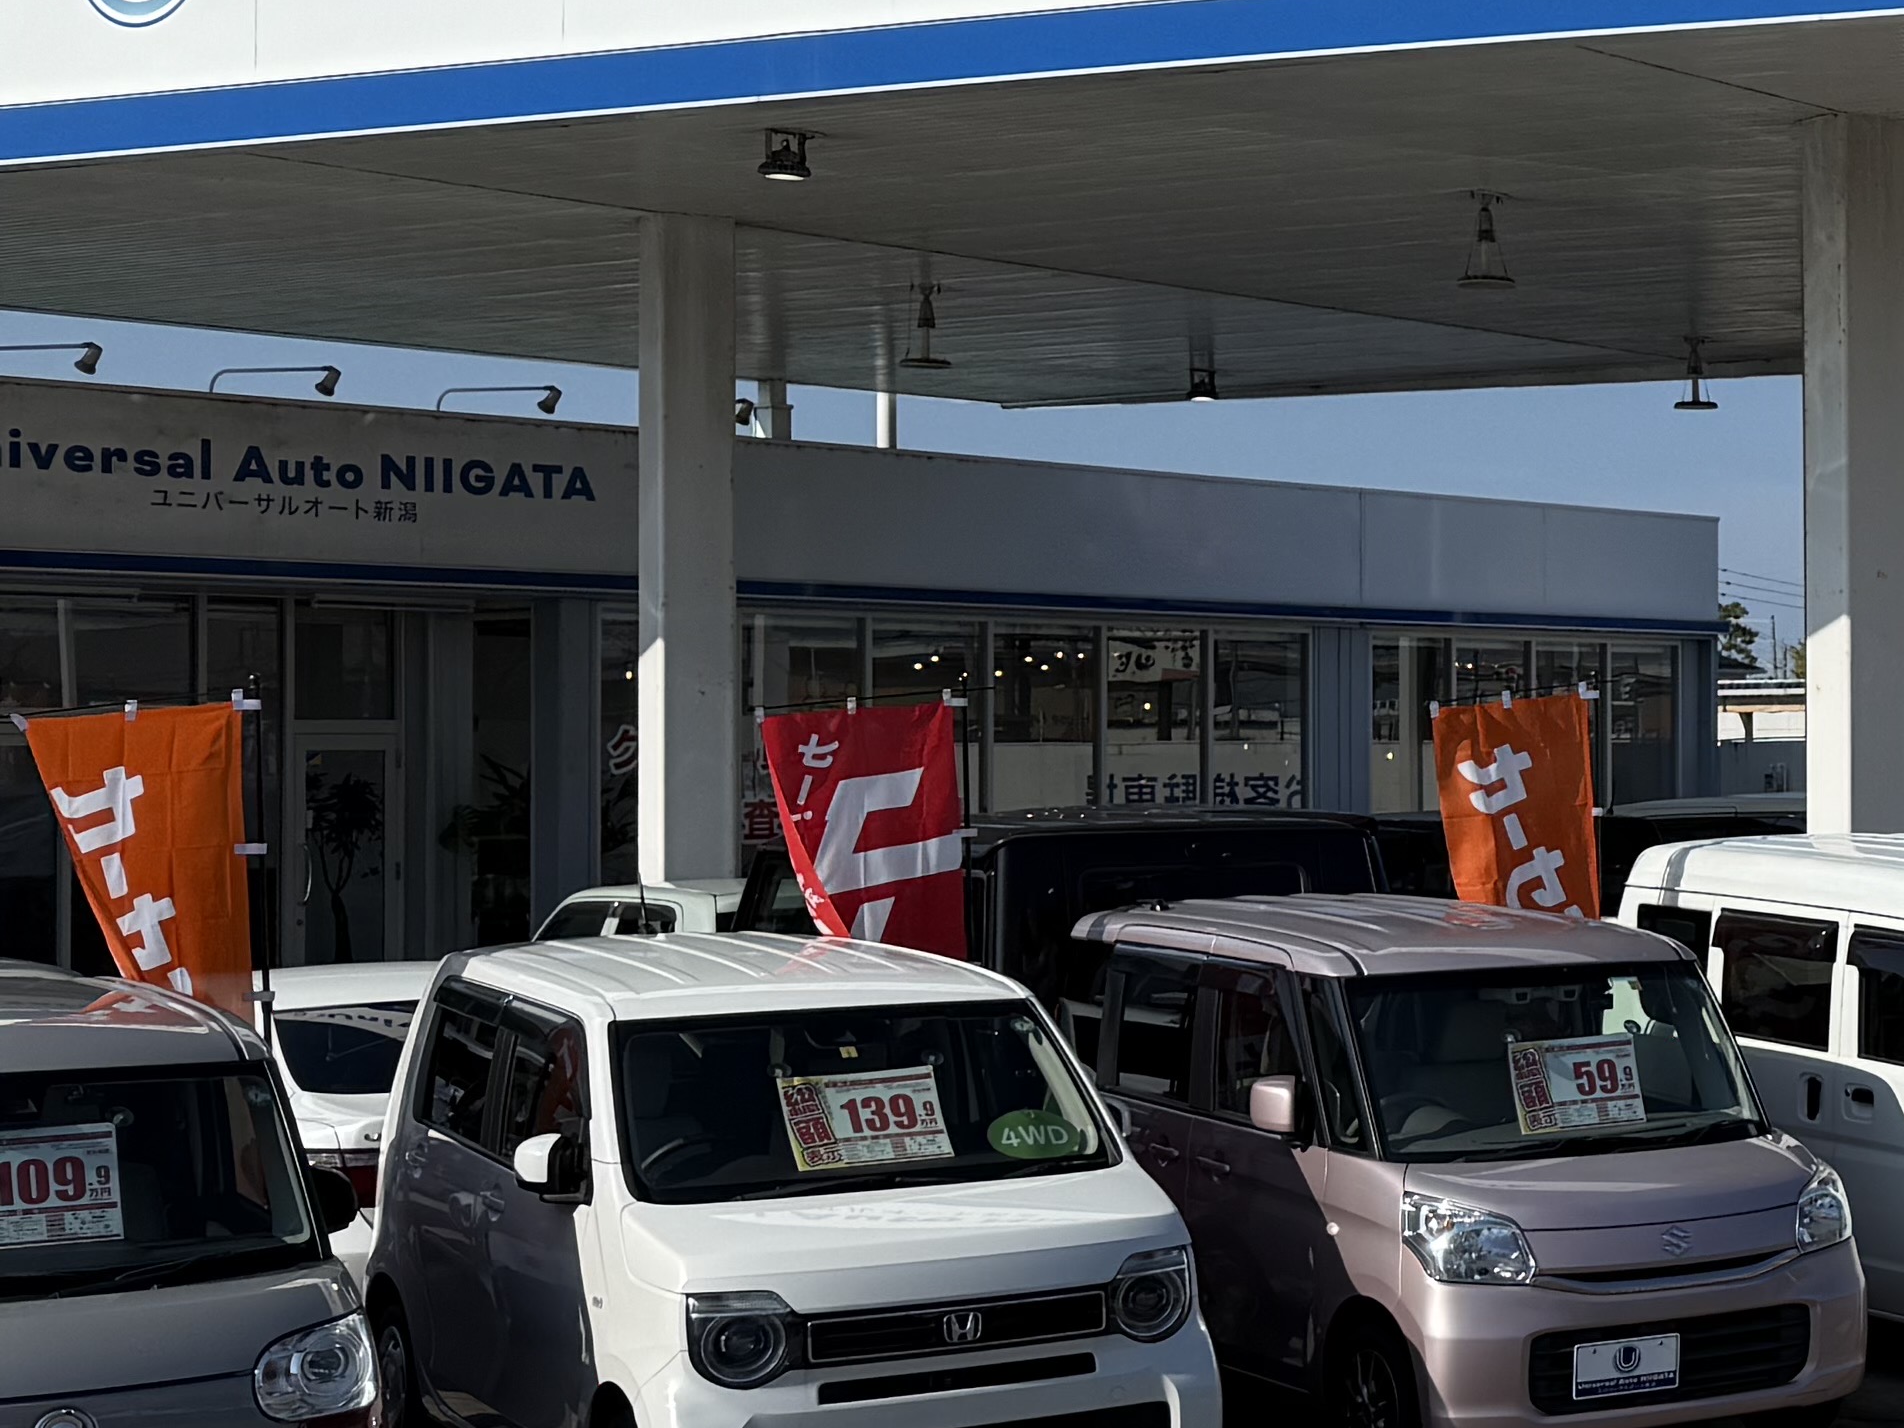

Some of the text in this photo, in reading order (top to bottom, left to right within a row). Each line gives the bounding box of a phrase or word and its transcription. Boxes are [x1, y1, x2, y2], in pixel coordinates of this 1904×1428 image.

[0, 427, 597, 503] iversal Auto NIIGATA
[150, 489, 418, 524] ユニバーサルオート新潟
[1457, 743, 1585, 918] カーセ
[1573, 1059, 1634, 1097] 59.9
[840, 1093, 936, 1134] 139.9
[1001, 1125, 1069, 1149] 4WD
[0, 1156, 110, 1207] 109.9
